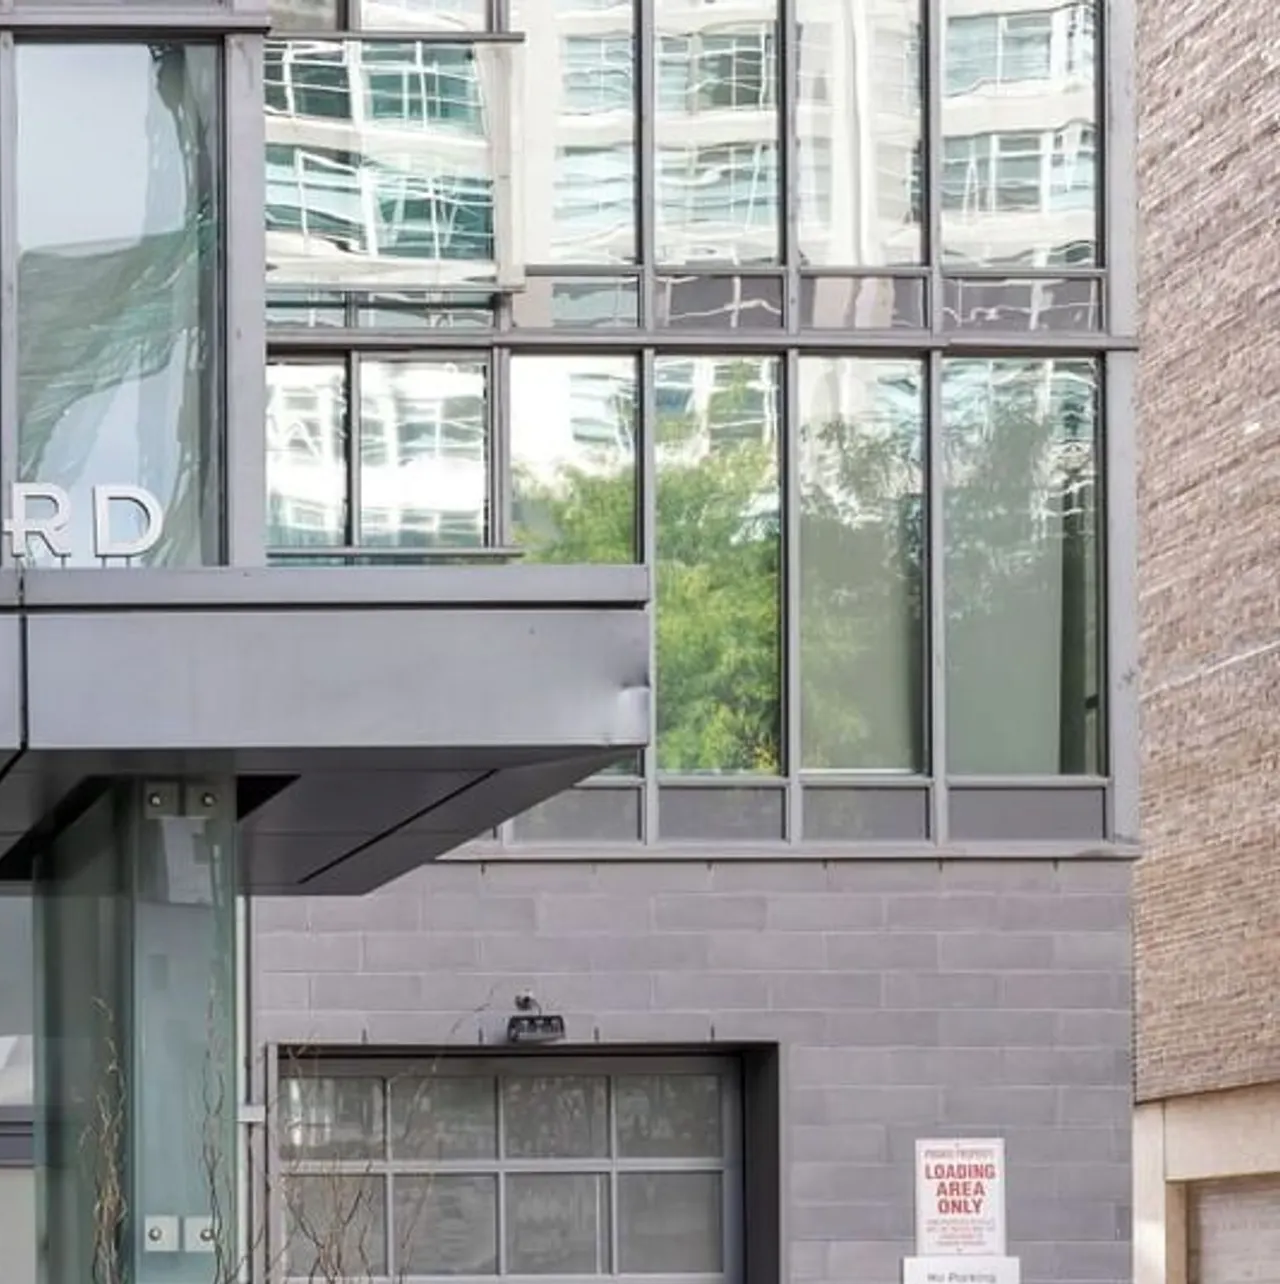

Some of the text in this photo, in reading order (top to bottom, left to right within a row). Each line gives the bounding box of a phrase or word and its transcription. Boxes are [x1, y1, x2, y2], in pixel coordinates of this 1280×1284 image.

[925, 1164, 996, 1180] LOADING
[936, 1181, 986, 1196] AREA
[937, 1198, 983, 1214] ONLY
